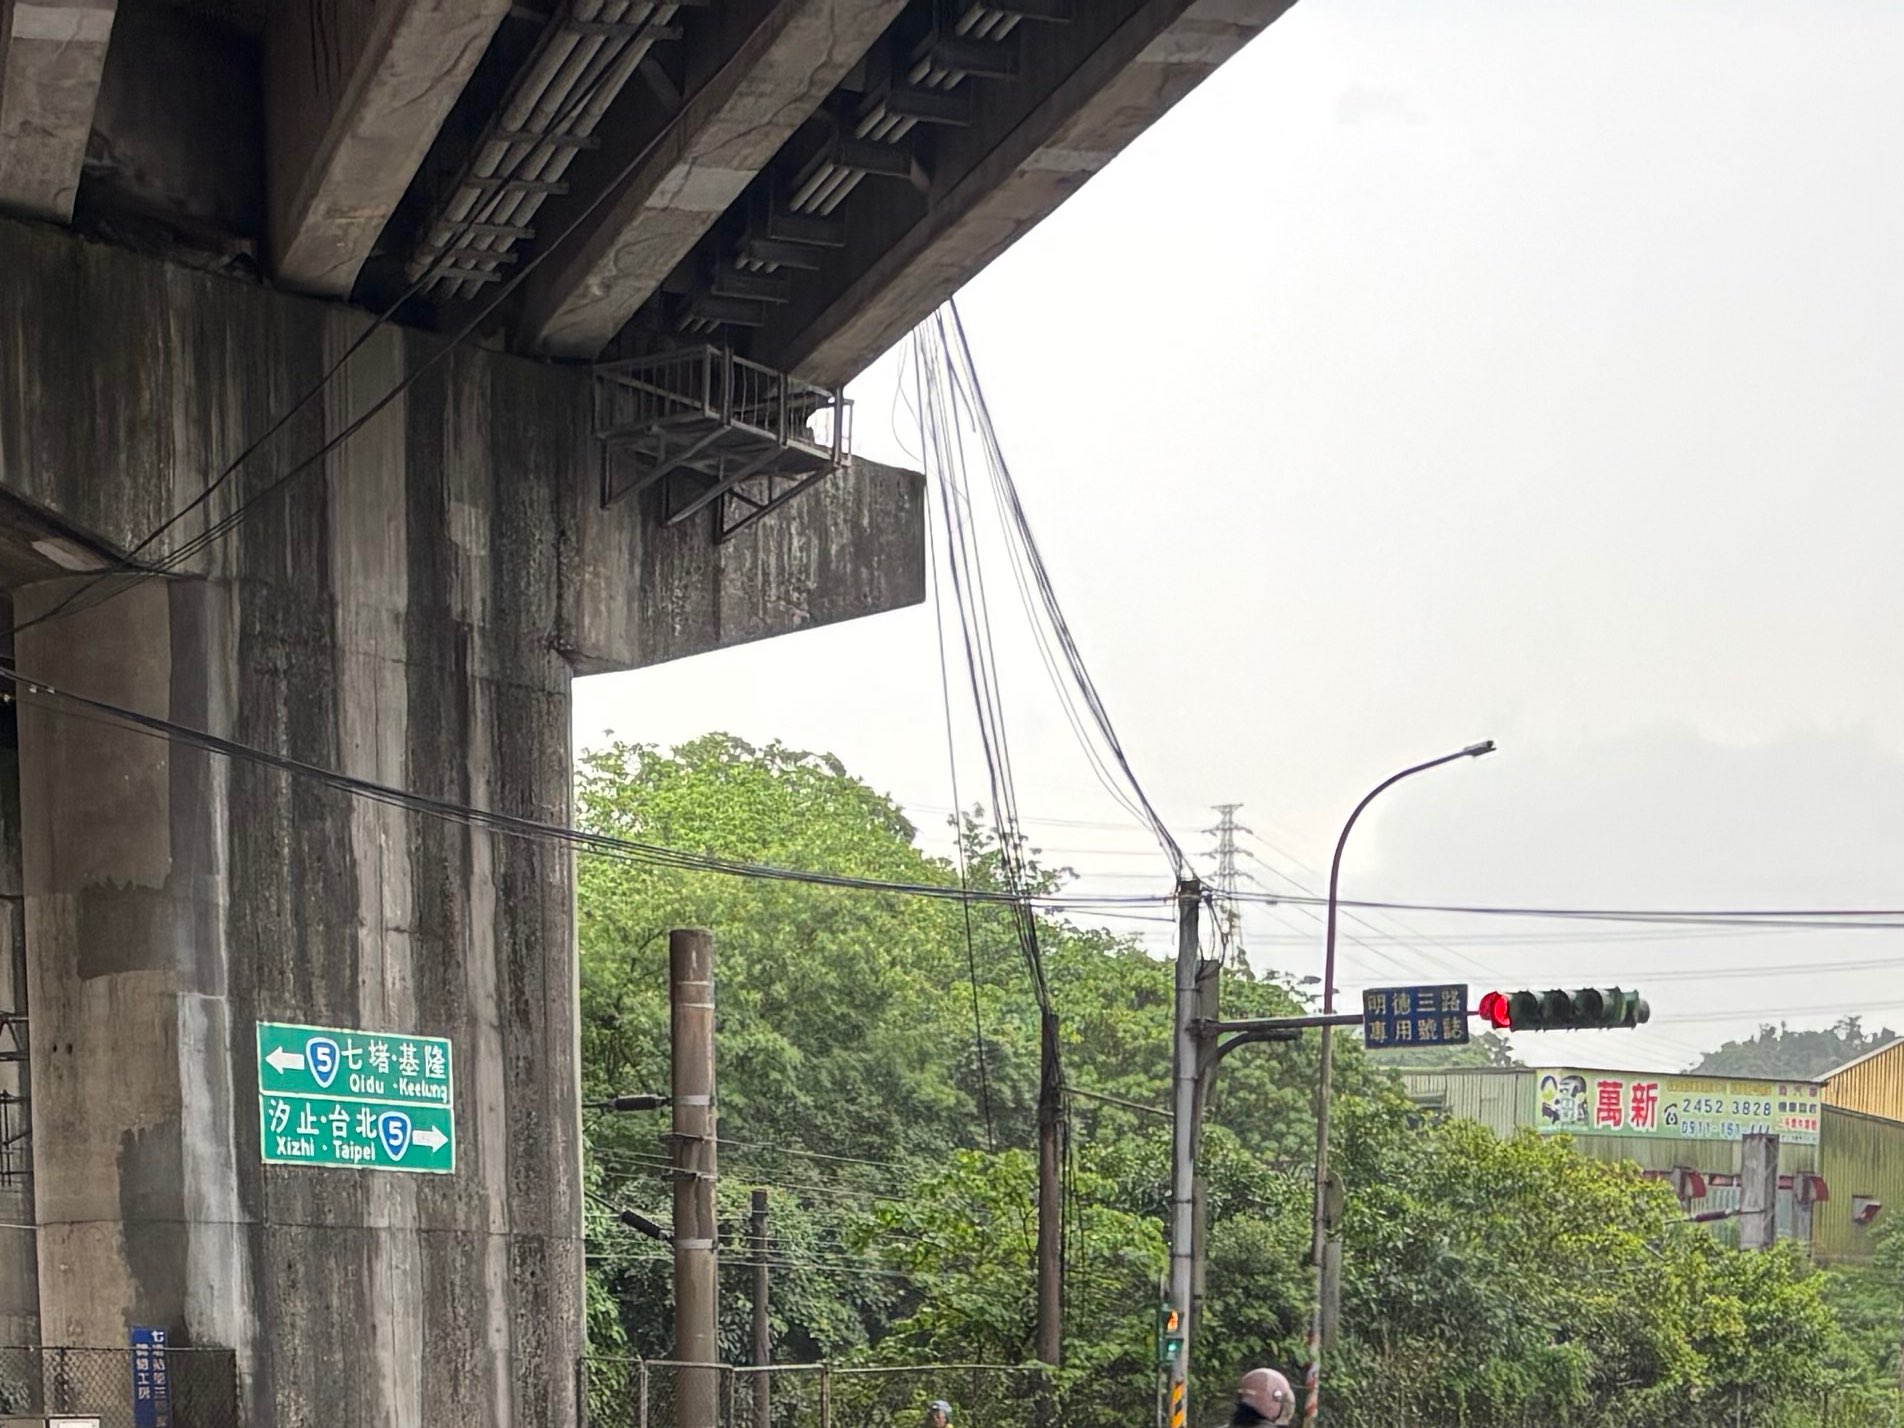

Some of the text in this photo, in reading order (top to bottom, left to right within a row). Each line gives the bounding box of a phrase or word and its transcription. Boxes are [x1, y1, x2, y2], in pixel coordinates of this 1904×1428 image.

[1368, 988, 1460, 1014] 明德三路
[316, 1047, 332, 1073] 5
[349, 1074, 384, 1094] Qidu
[1597, 1081, 1658, 1128] 萬新
[1682, 1099, 1723, 1114] 2452
[1732, 1101, 1771, 1116] 3828
[388, 1121, 403, 1146] 5
[276, 1136, 376, 1163] Xizhi Taipei
